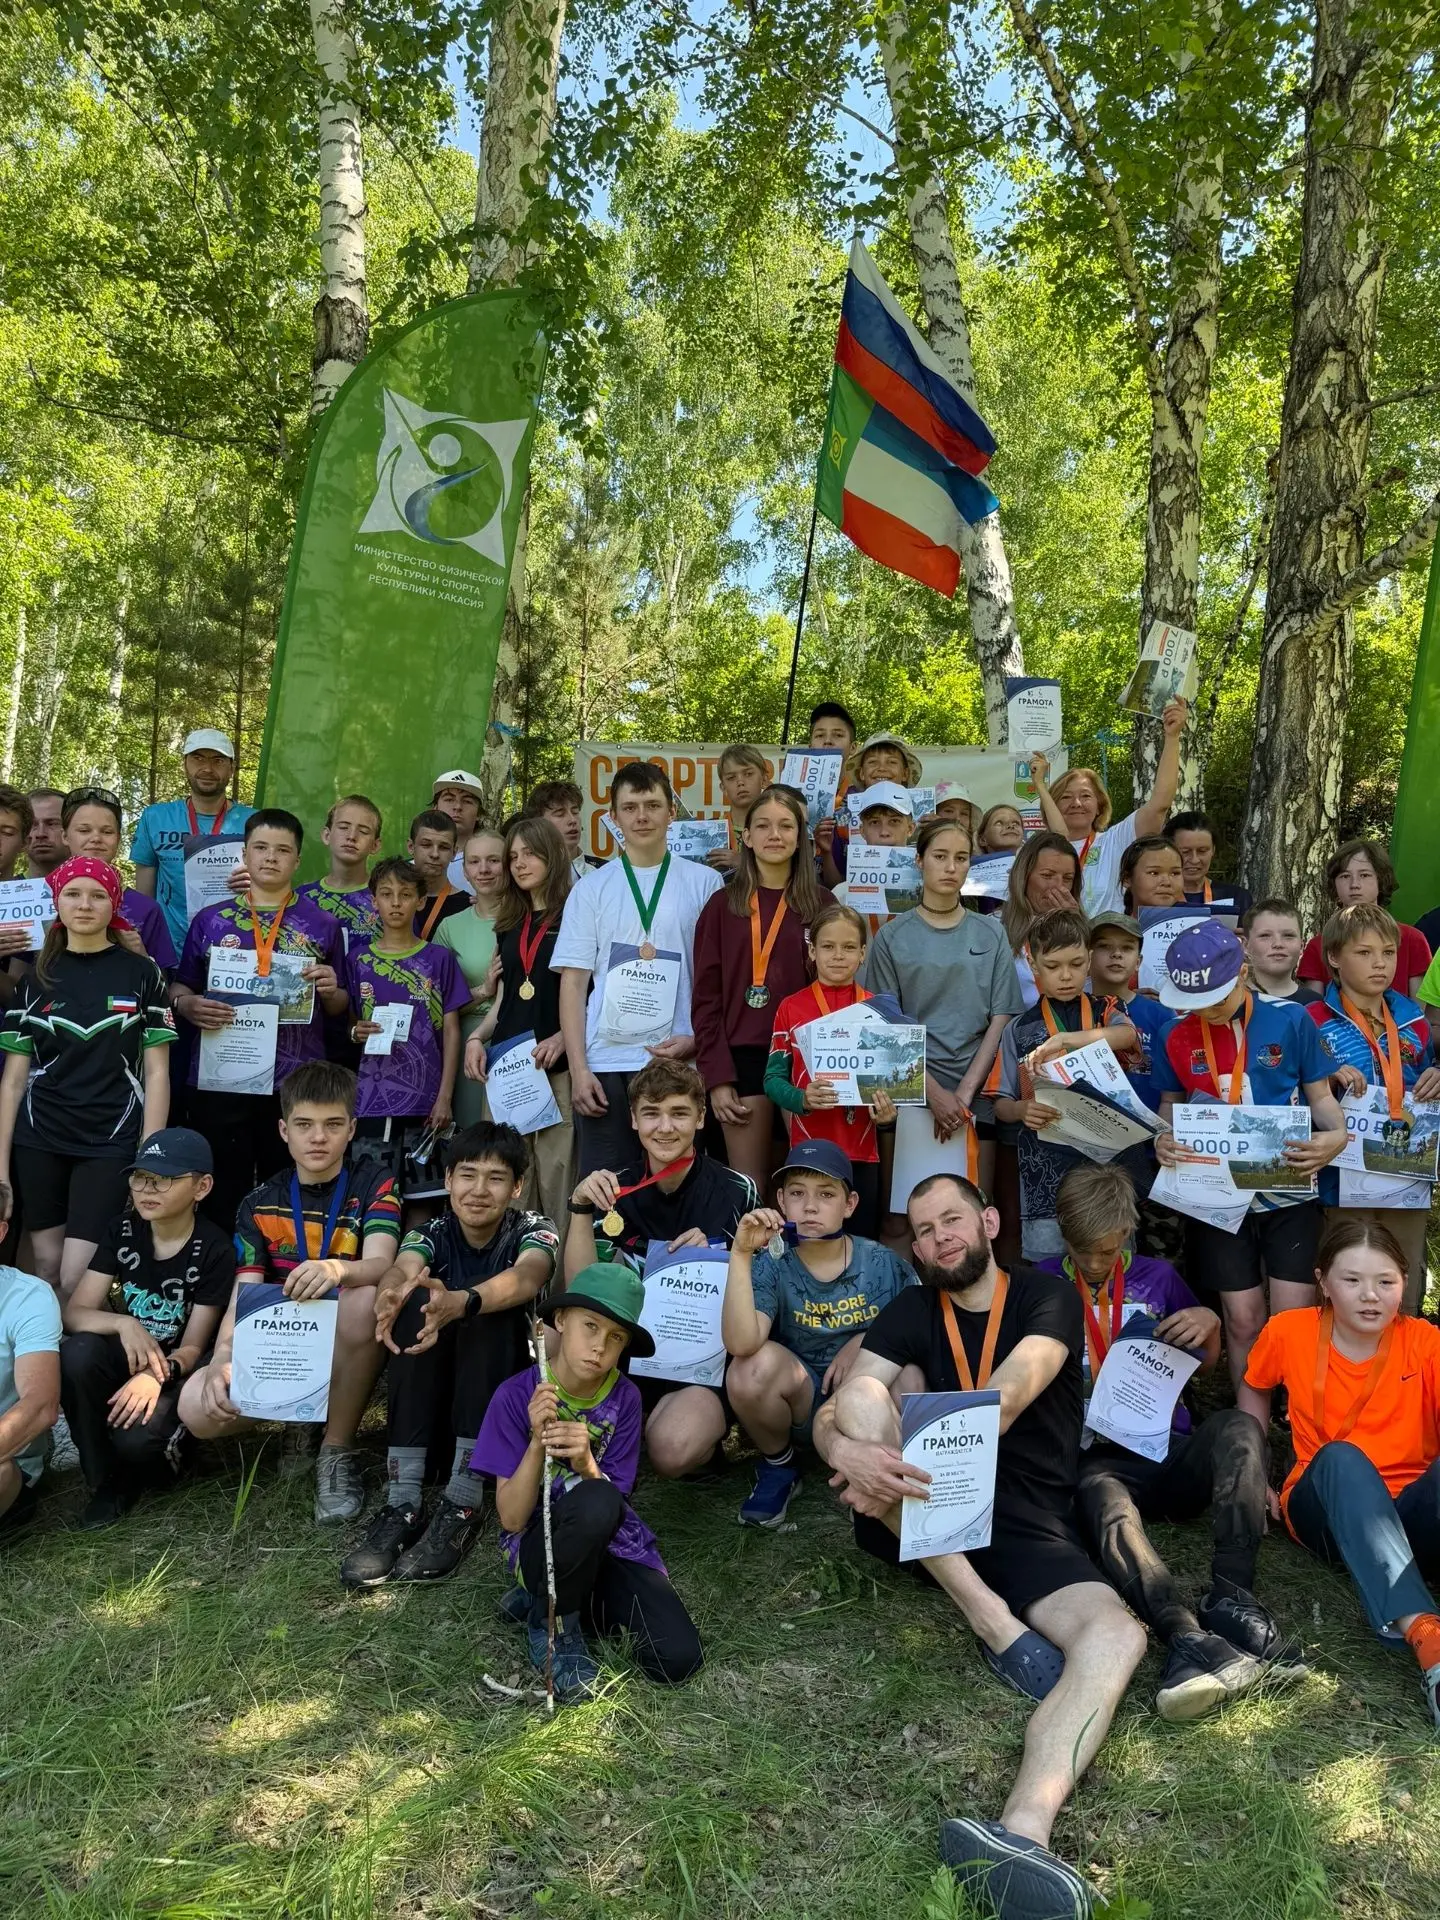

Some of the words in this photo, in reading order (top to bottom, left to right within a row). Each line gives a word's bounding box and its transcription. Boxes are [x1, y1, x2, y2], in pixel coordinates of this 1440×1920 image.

[354, 543, 436, 570] МИНИСТЕРСТВО
[439, 564, 504, 587] ФИЗИЧЕСКОЙ
[376, 562, 430, 582] КУЛЬТУРЫ
[432, 576, 439, 584] И
[441, 578, 481, 595] СПОРТА
[368, 574, 436, 598] РЕСПУБЛИКИ
[437, 591, 484, 609] ХАКАСИЯ
[1018, 698, 1054, 706] ГРАМОТА
[197, 856, 240, 865] ГРАМОТА
[1152, 931, 1180, 940] ГРАМ
[621, 968, 667, 983] ГРАМОТА
[1171, 967, 1212, 987] OBEY
[494, 1058, 531, 1077] ГРАМОТА
[814, 1056, 822, 1069] 7
[826, 1055, 859, 1069] 000
[660, 1277, 719, 1295] ГРАМОТА
[804, 1294, 867, 1315] EXPLORE
[254, 1319, 319, 1331] ГРАМОТА
[794, 1310, 822, 1328] THE
[826, 1305, 880, 1329] WORLD
[1127, 1345, 1174, 1379] ГРАМОТА
[923, 1433, 984, 1450] ГРАМОТА
